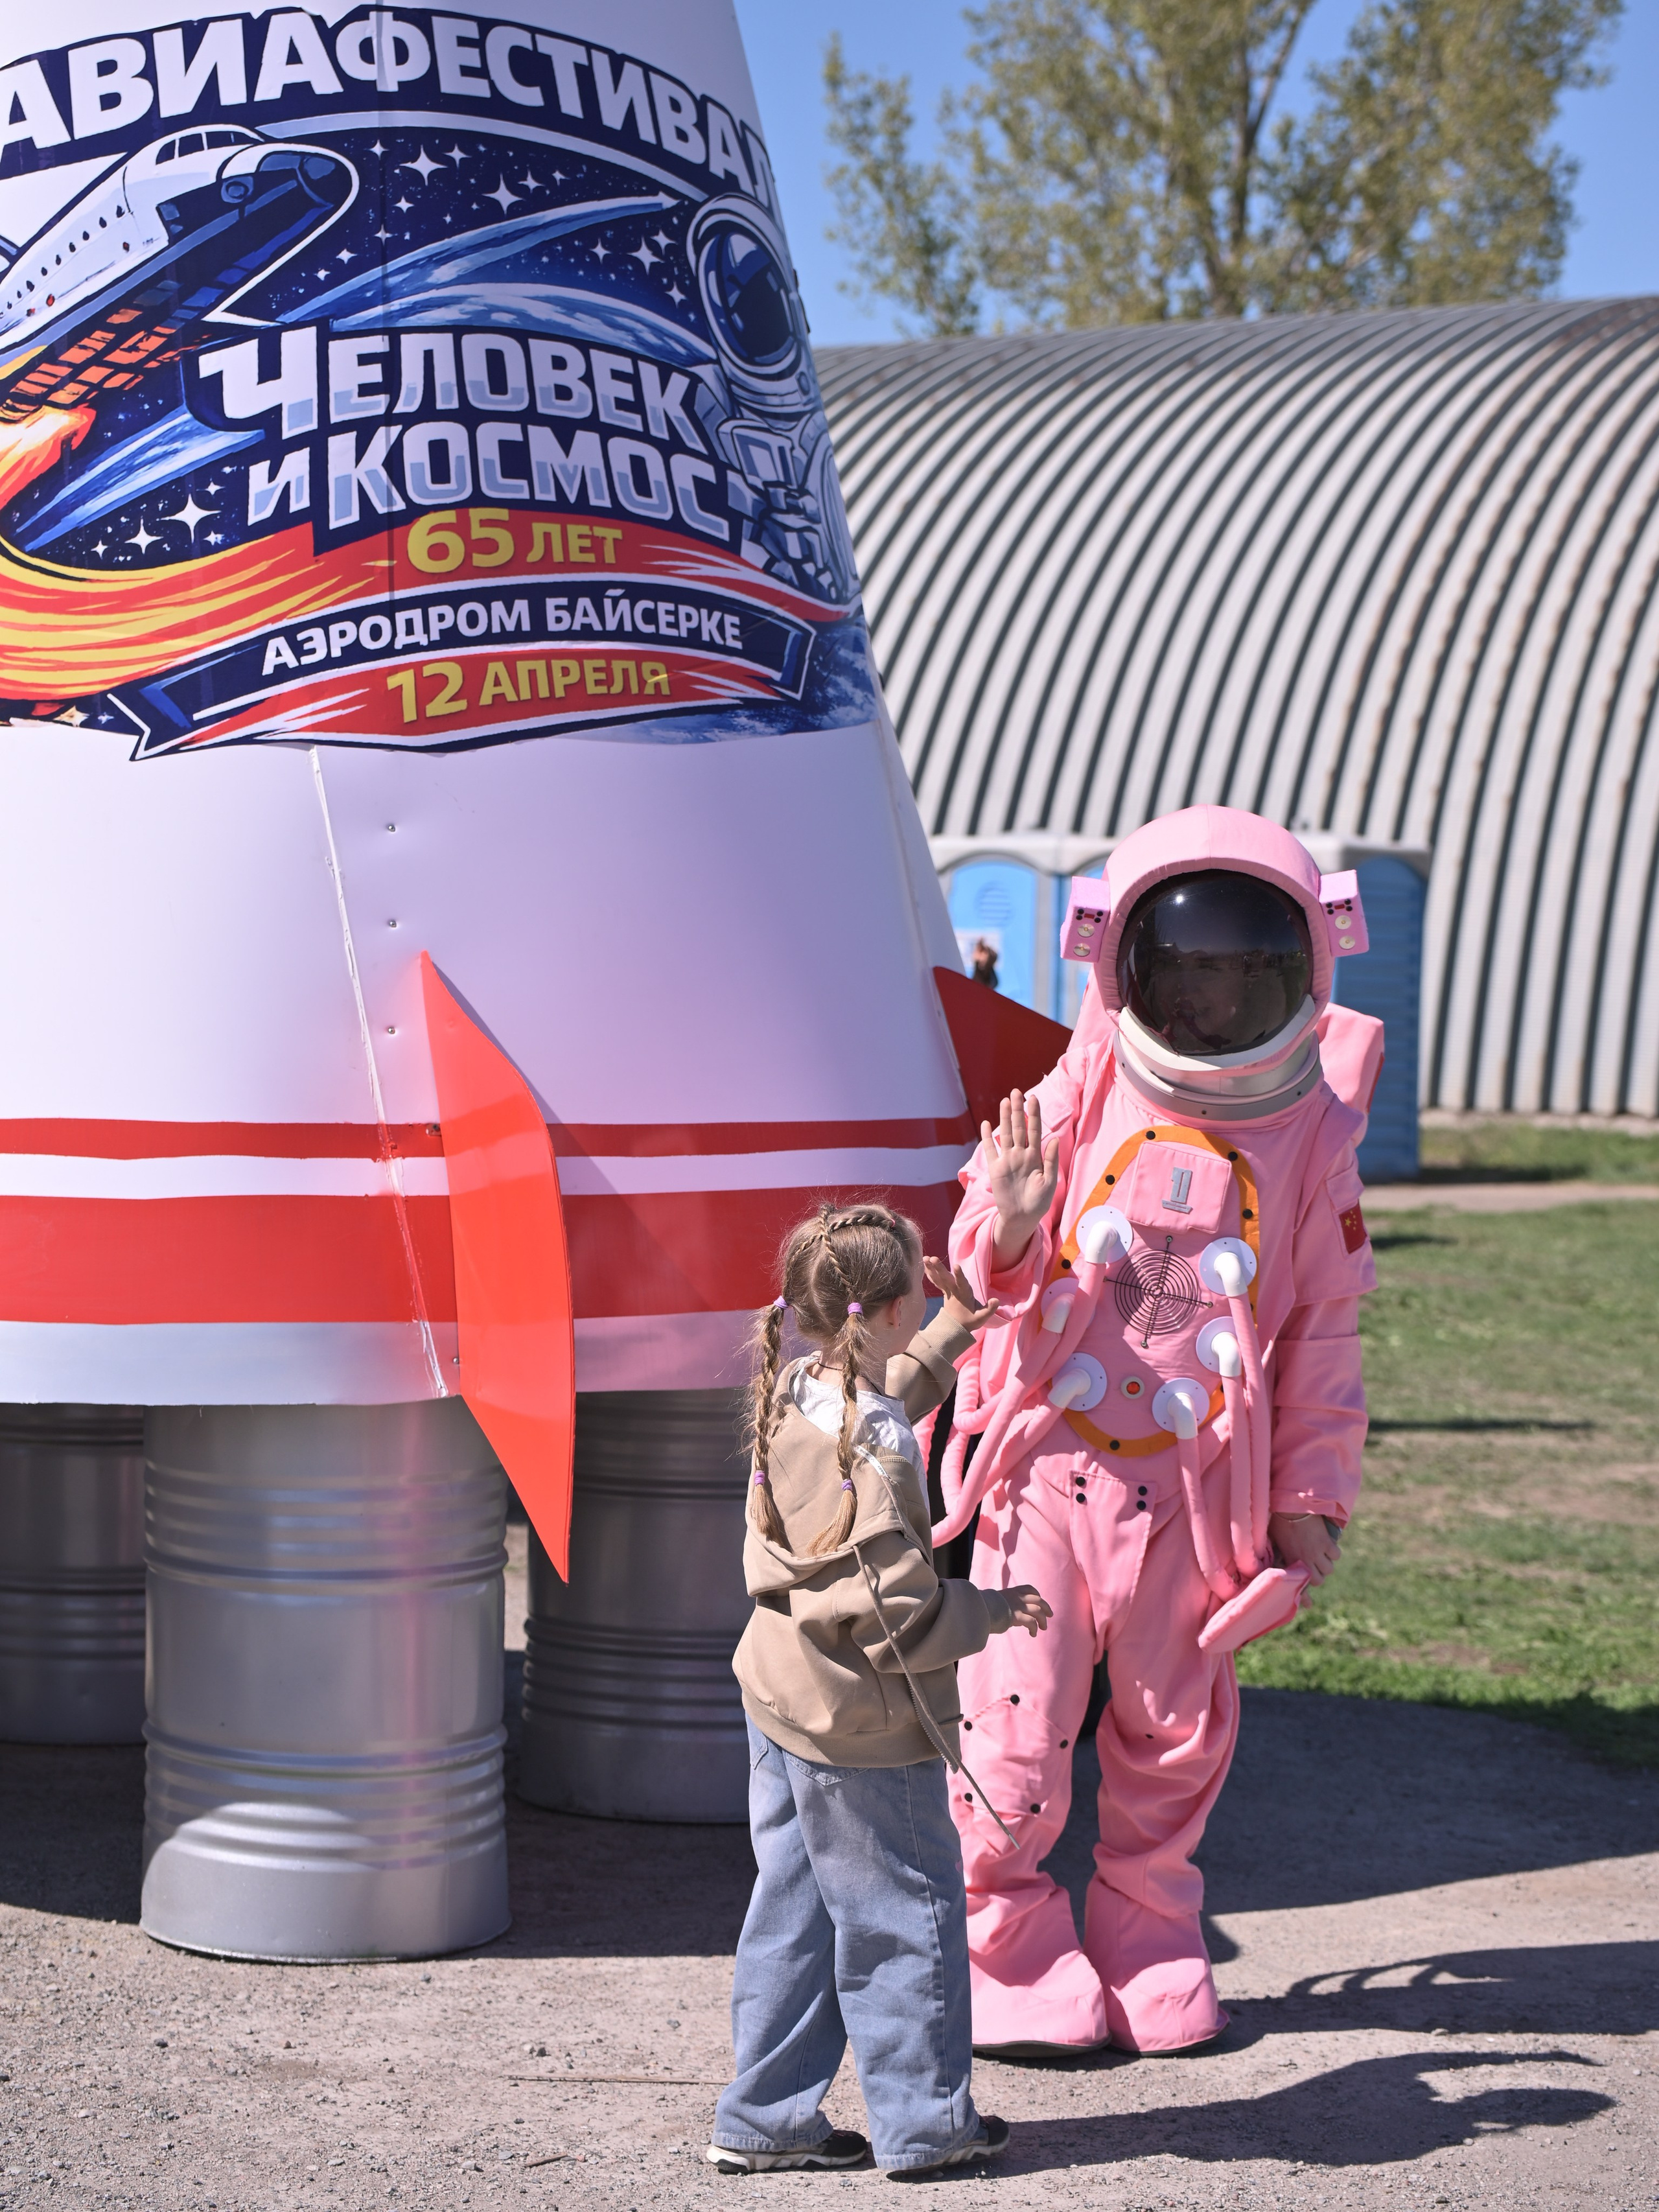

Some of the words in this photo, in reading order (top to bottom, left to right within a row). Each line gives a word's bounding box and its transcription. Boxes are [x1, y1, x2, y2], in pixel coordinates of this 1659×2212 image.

[199, 326, 708, 455] ЧЕЛОВЕК
[328, 421, 729, 541] КОСМОС
[407, 508, 515, 573] 65
[526, 522, 623, 564] ЛЕТ
[261, 598, 531, 675] АЭРОДРОМ
[546, 589, 743, 649] БАЙСЕРКЕ
[388, 662, 468, 723] 12
[479, 660, 671, 706] АПРЕЛЯ
